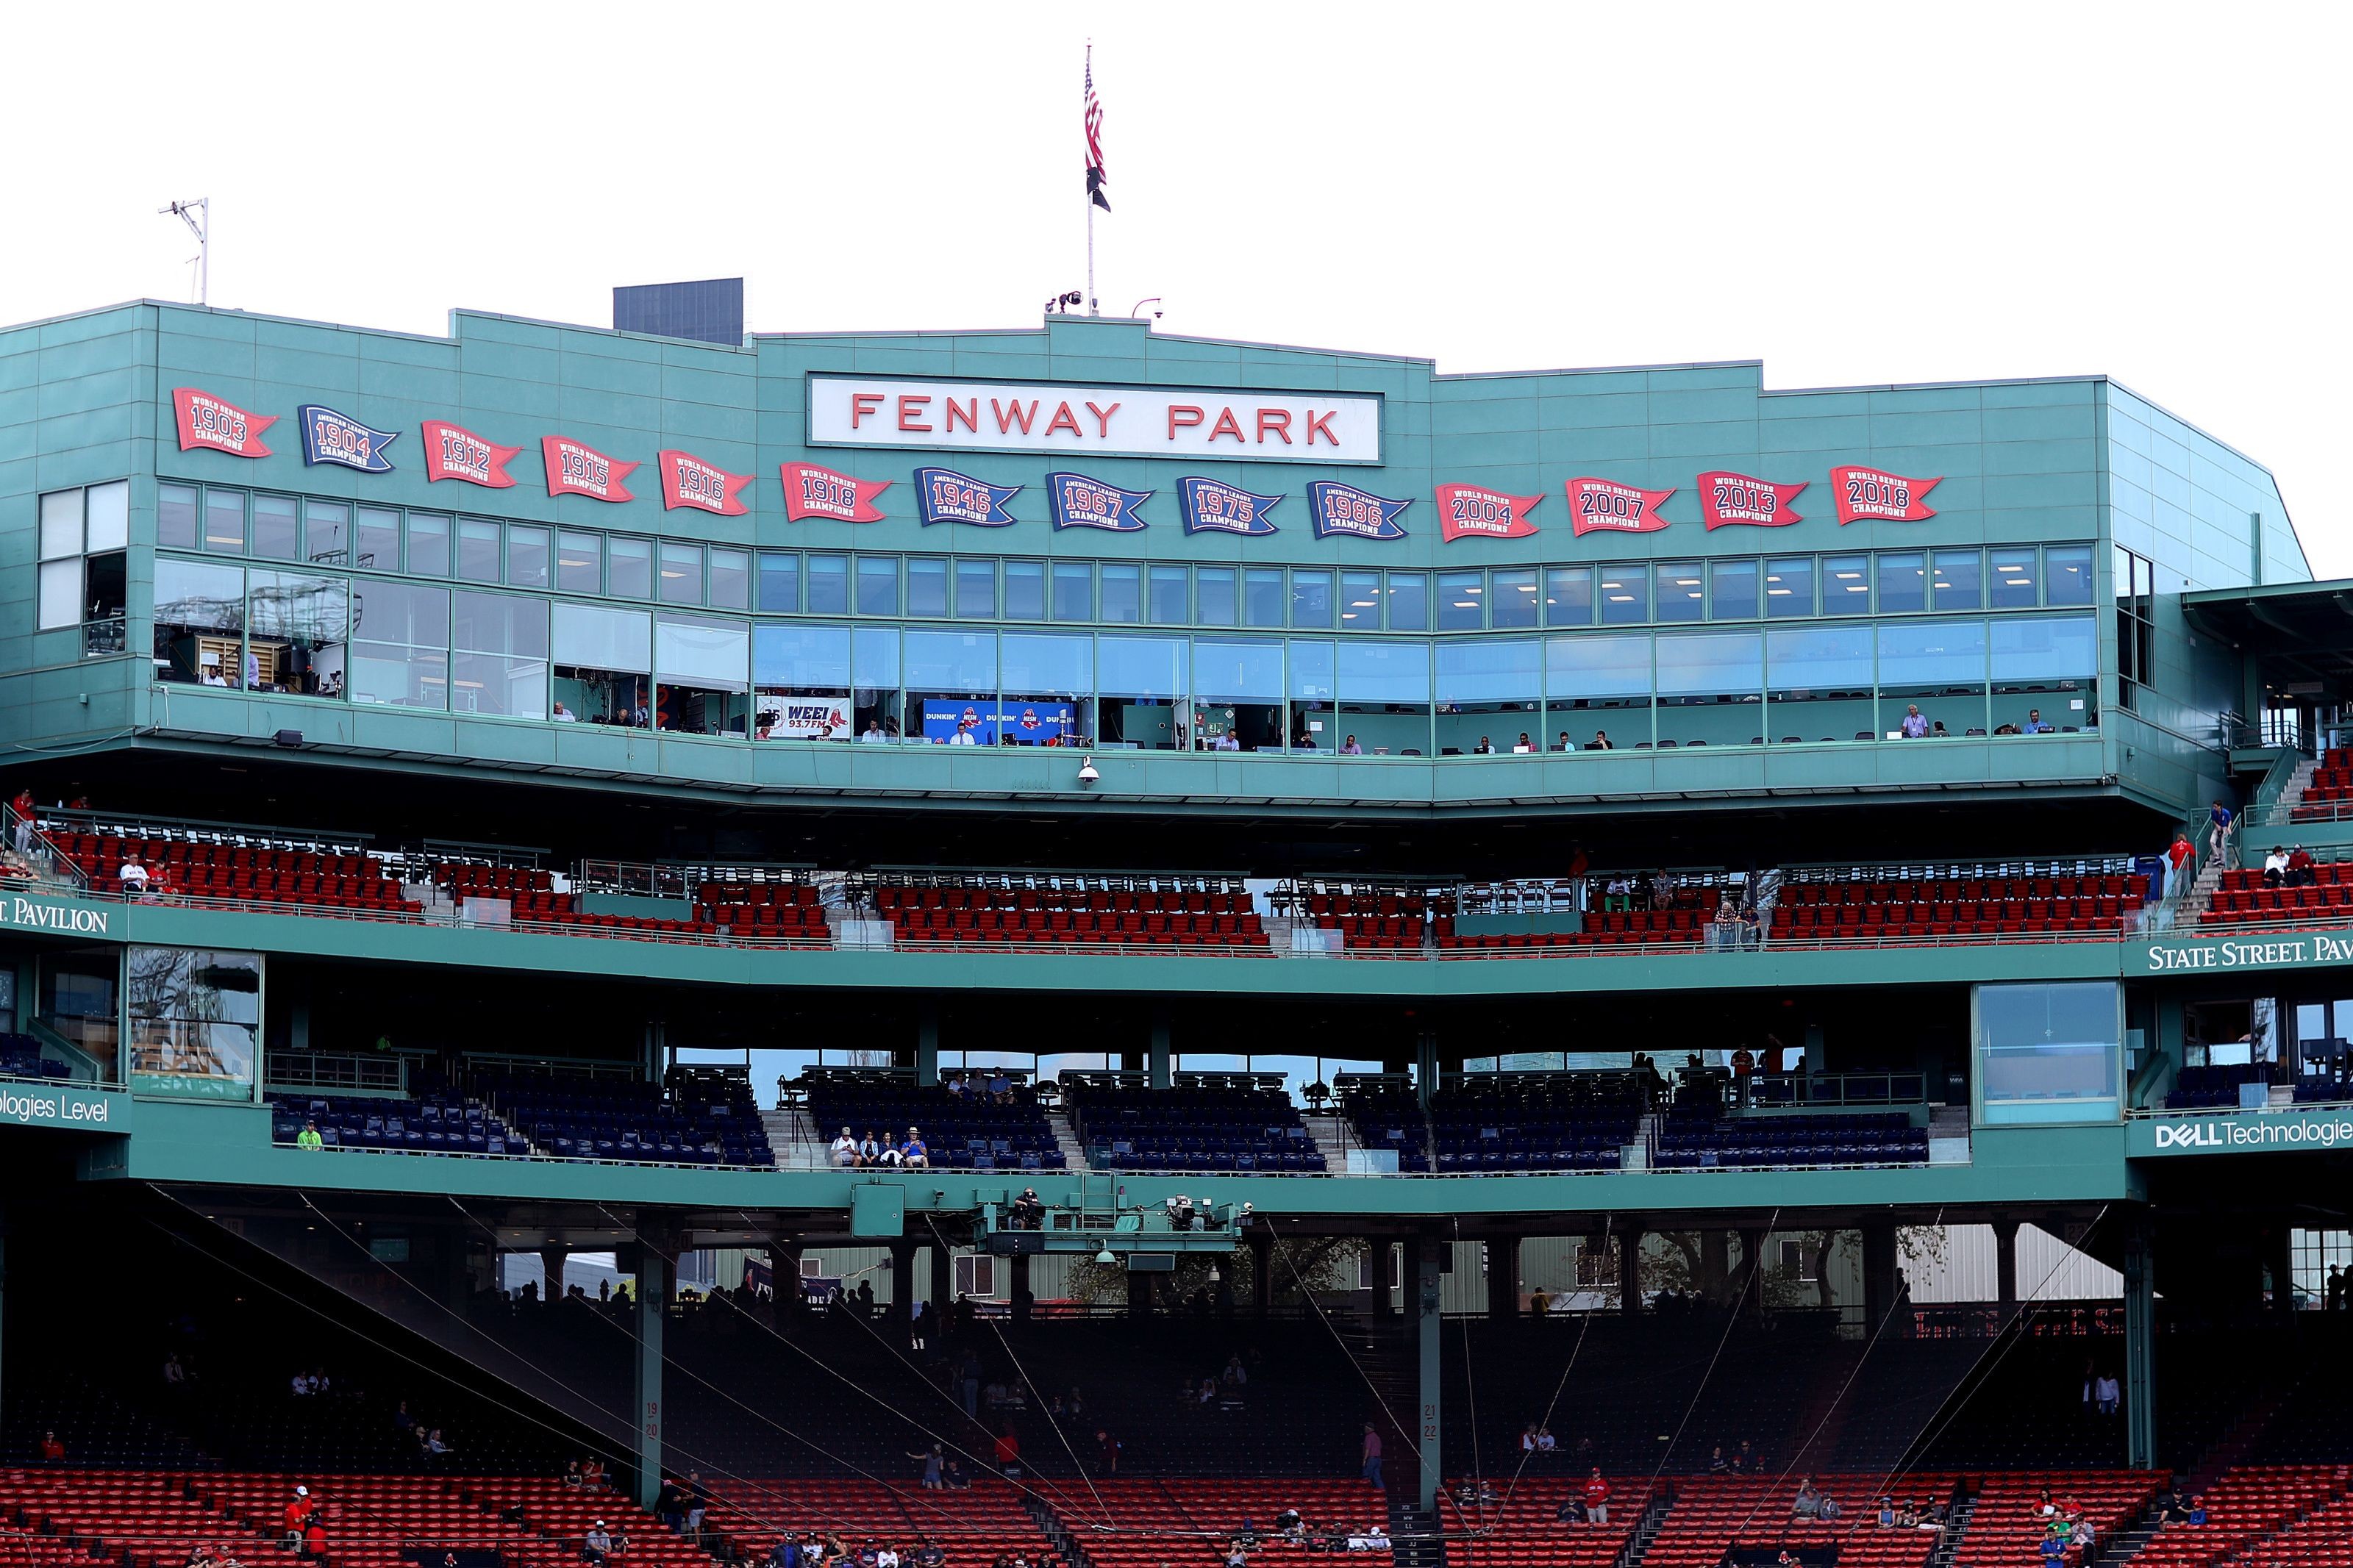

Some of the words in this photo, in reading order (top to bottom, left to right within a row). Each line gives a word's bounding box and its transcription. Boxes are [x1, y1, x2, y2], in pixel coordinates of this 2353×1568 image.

[192, 396, 218, 410] WORLD
[219, 405, 246, 421] SERIES
[190, 407, 247, 443] 1903
[317, 415, 346, 426] AMERICAN
[347, 424, 369, 437] LEAGUE
[851, 393, 1121, 438] FENWAY
[1168, 404, 1340, 445] PARK
[195, 430, 243, 451] CHAMPIONS
[315, 422, 371, 458] 1904
[440, 429, 465, 442] WORLD
[466, 437, 490, 452] SERIES
[321, 446, 368, 465] CHAMPIONS
[442, 439, 490, 473] 1912
[559, 443, 584, 457] WORLD
[585, 451, 609, 467] SERIES
[443, 462, 488, 482] CHAMPIONS
[560, 453, 609, 487] 1915
[676, 458, 701, 470] WORLD
[701, 465, 724, 481] SERIES
[563, 476, 607, 495] CHAMPIONS
[677, 466, 724, 501] 1916
[800, 470, 828, 480] WORLD
[829, 475, 857, 489] SERIES
[934, 476, 965, 485] AMERICAN
[965, 482, 989, 493] LEAGUE
[1715, 477, 1744, 487] WORLD
[1746, 481, 1774, 493] SERIES
[1848, 472, 1877, 482] WORLD
[1879, 476, 1907, 487] SERIES
[801, 478, 856, 507] 1918
[932, 483, 990, 512] 1946
[1065, 481, 1097, 490] AMERICAN
[1098, 487, 1121, 498] LEAGUE
[1197, 484, 1229, 494] AMERICAN
[1229, 490, 1252, 501] LEAGUE
[1327, 488, 1358, 498] AMERICAN
[1359, 494, 1380, 506] LEAGUE
[1454, 490, 1481, 500] WORLD
[1483, 493, 1510, 505] SERIES
[1582, 484, 1611, 493] WORLD
[1613, 487, 1641, 498] SERIES
[1846, 479, 1909, 508] 2018
[679, 490, 723, 509] CHAMPIONS
[804, 501, 854, 517] CHAMPIONS
[1064, 488, 1123, 518] 1967
[1196, 491, 1254, 522] 1975
[1579, 492, 1644, 520] 2007
[1713, 485, 1777, 514] 2013
[937, 505, 988, 521] CHAMPIONS
[1069, 510, 1119, 526] CHAMPIONS
[1326, 495, 1382, 526] 1986
[1451, 498, 1513, 525] 2004
[1719, 510, 1772, 522] CHAMPIONS
[1853, 504, 1906, 518] CHAMPIONS
[1200, 514, 1250, 530] CHAMPIONS
[1329, 518, 1378, 534] CHAMPIONS
[1458, 520, 1507, 533] CHAMPIONS
[1587, 516, 1640, 529] CHAMPIONS
[788, 706, 829, 720] WEEI
[13, 898, 108, 934] PAVILION
[2148, 945, 2217, 970] STATE
[0, 1089, 56, 1122] logies
[61, 1095, 107, 1122] Level
[2155, 1123, 2223, 1148] DELL
[647, 1402, 657, 1414] 19
[1425, 1405, 1435, 1416] 21
[646, 1424, 657, 1436] 20
[1424, 1425, 1436, 1436] 22
